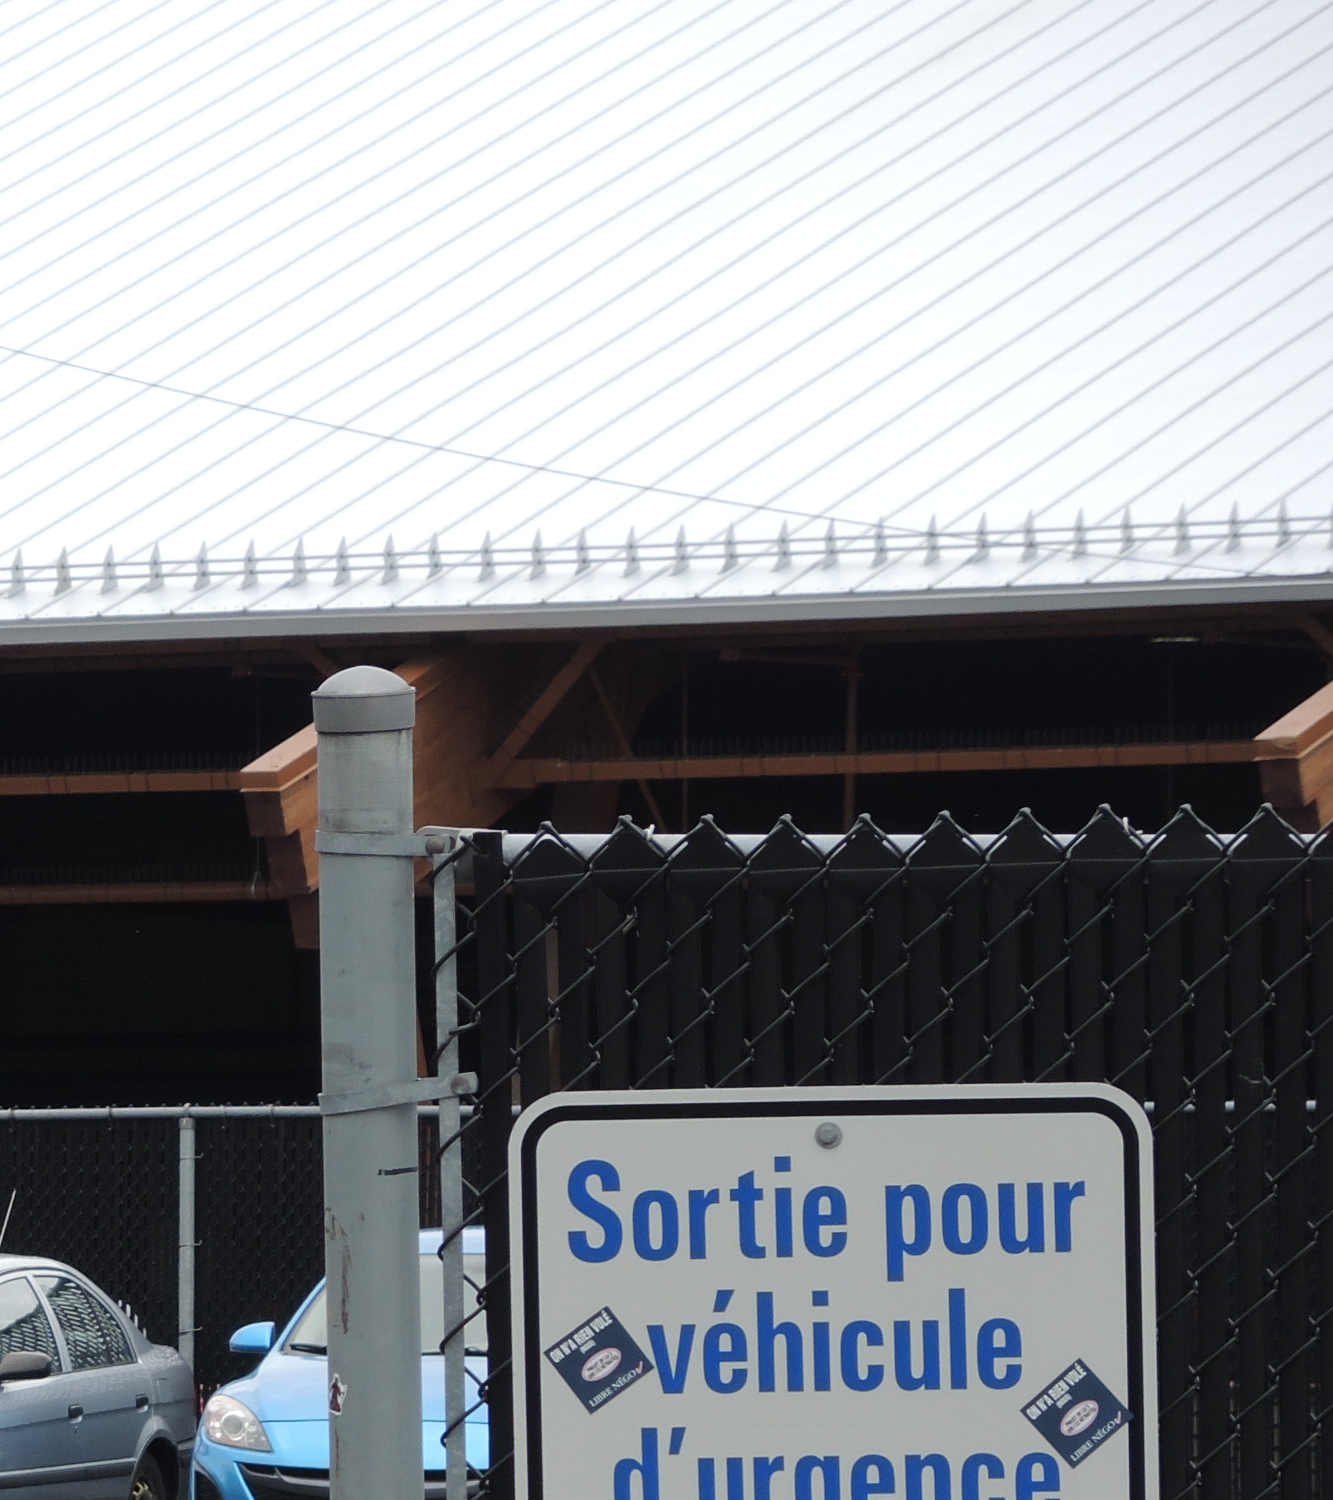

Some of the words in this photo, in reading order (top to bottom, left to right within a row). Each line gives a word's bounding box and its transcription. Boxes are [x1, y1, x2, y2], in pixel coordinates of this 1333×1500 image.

[569, 1157, 847, 1262] Sortie
[886, 1182, 1084, 1280] pour
[549, 1347, 565, 1363] ON
[572, 1325, 595, 1346] RIEN
[589, 1309, 613, 1333] VOLÉ
[649, 1289, 1021, 1393] véhicule
[589, 1387, 614, 1407] LIBRE
[611, 1369, 637, 1391] NÉGO
[1026, 1404, 1042, 1420] ON
[1064, 1362, 1087, 1386] VOLÉ
[1070, 1440, 1094, 1462] LIBRE
[1091, 1421, 1116, 1443] NÉGO
